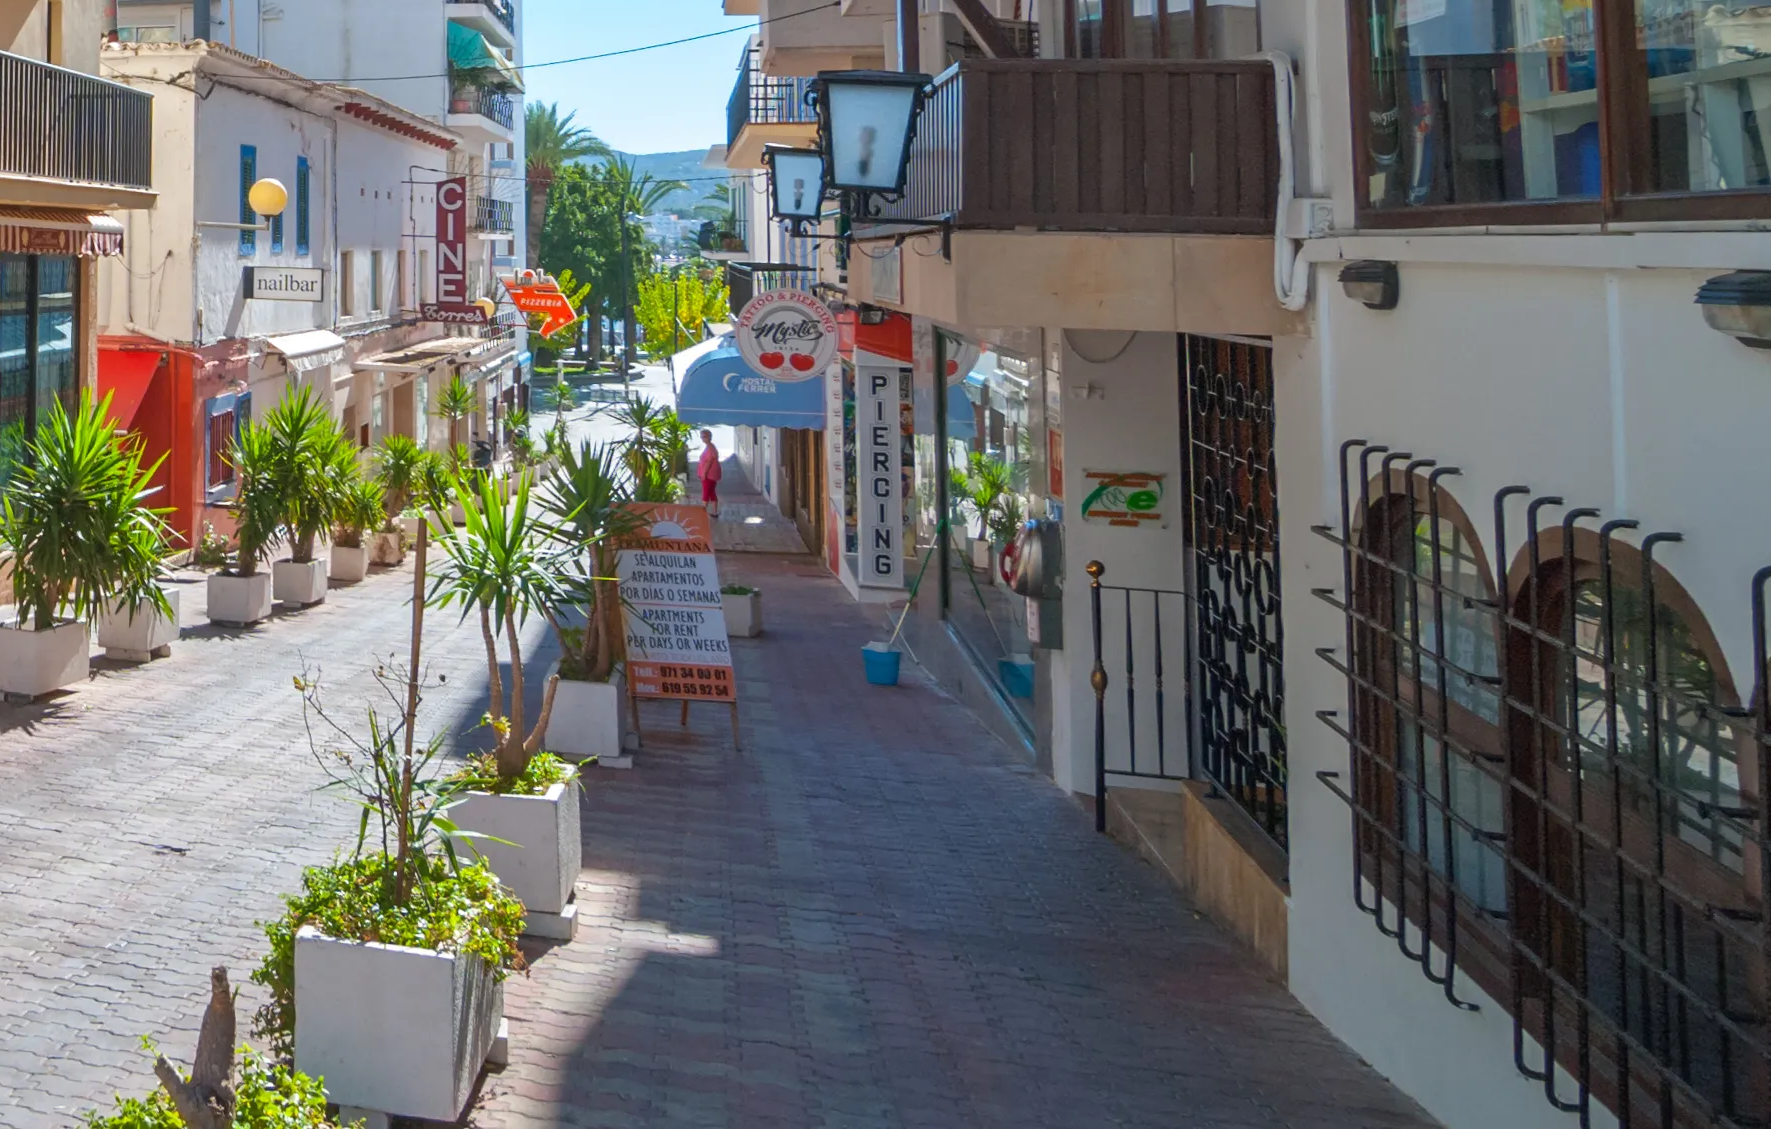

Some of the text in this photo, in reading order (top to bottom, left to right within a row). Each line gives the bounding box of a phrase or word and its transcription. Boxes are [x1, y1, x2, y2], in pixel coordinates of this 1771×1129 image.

[438, 183, 463, 302] CINE
[257, 274, 318, 292] nailbar
[520, 298, 562, 307] PIZZERIA
[740, 292, 834, 333] TATTOO & PIERCING
[737, 384, 776, 393] FERRER
[741, 377, 774, 385] HOSTAL
[870, 374, 893, 576] PIERCING
[635, 553, 696, 569] SE ALQUILAN
[632, 571, 704, 586] APARTAMENTOS
[620, 587, 640, 599] POR
[668, 589, 674, 601] O
[677, 589, 720, 603] SEMANAS
[643, 609, 704, 624] APARTMENTS
[652, 623, 698, 636] FOR RENT
[649, 636, 673, 650] DAYS
[676, 638, 690, 650] OR
[693, 639, 728, 652] WEEKS
[660, 666, 677, 677] 971
[681, 667, 694, 678] 34
